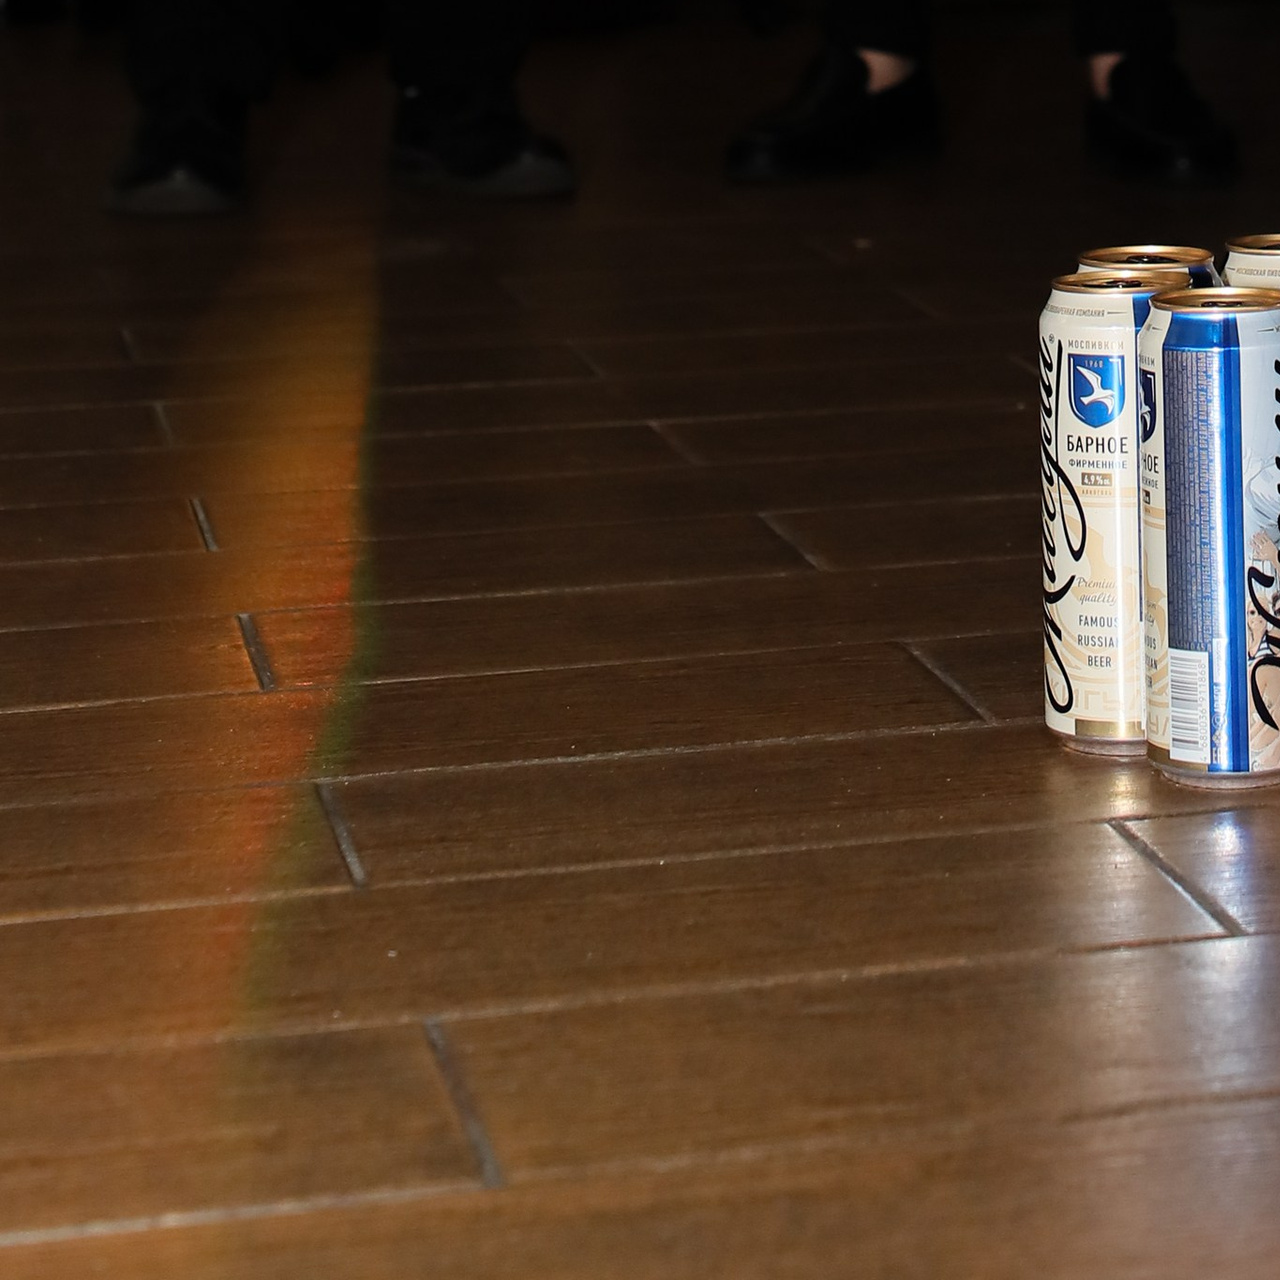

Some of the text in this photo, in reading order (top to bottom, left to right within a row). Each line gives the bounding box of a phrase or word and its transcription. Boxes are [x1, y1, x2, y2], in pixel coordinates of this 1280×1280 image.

[1068, 339, 1124, 350] МОСПИВКОМ
[1066, 434, 1129, 454] БАРНОЕ
[1068, 458, 1128, 469] ФИРМЕННОЕ
[1079, 592, 1118, 607] quality
[1078, 614, 1119, 628] FAMOUS
[1087, 654, 1112, 668] BEER
[1197, 662, 1207, 703] 911868
[1199, 707, 1208, 748] 680036
